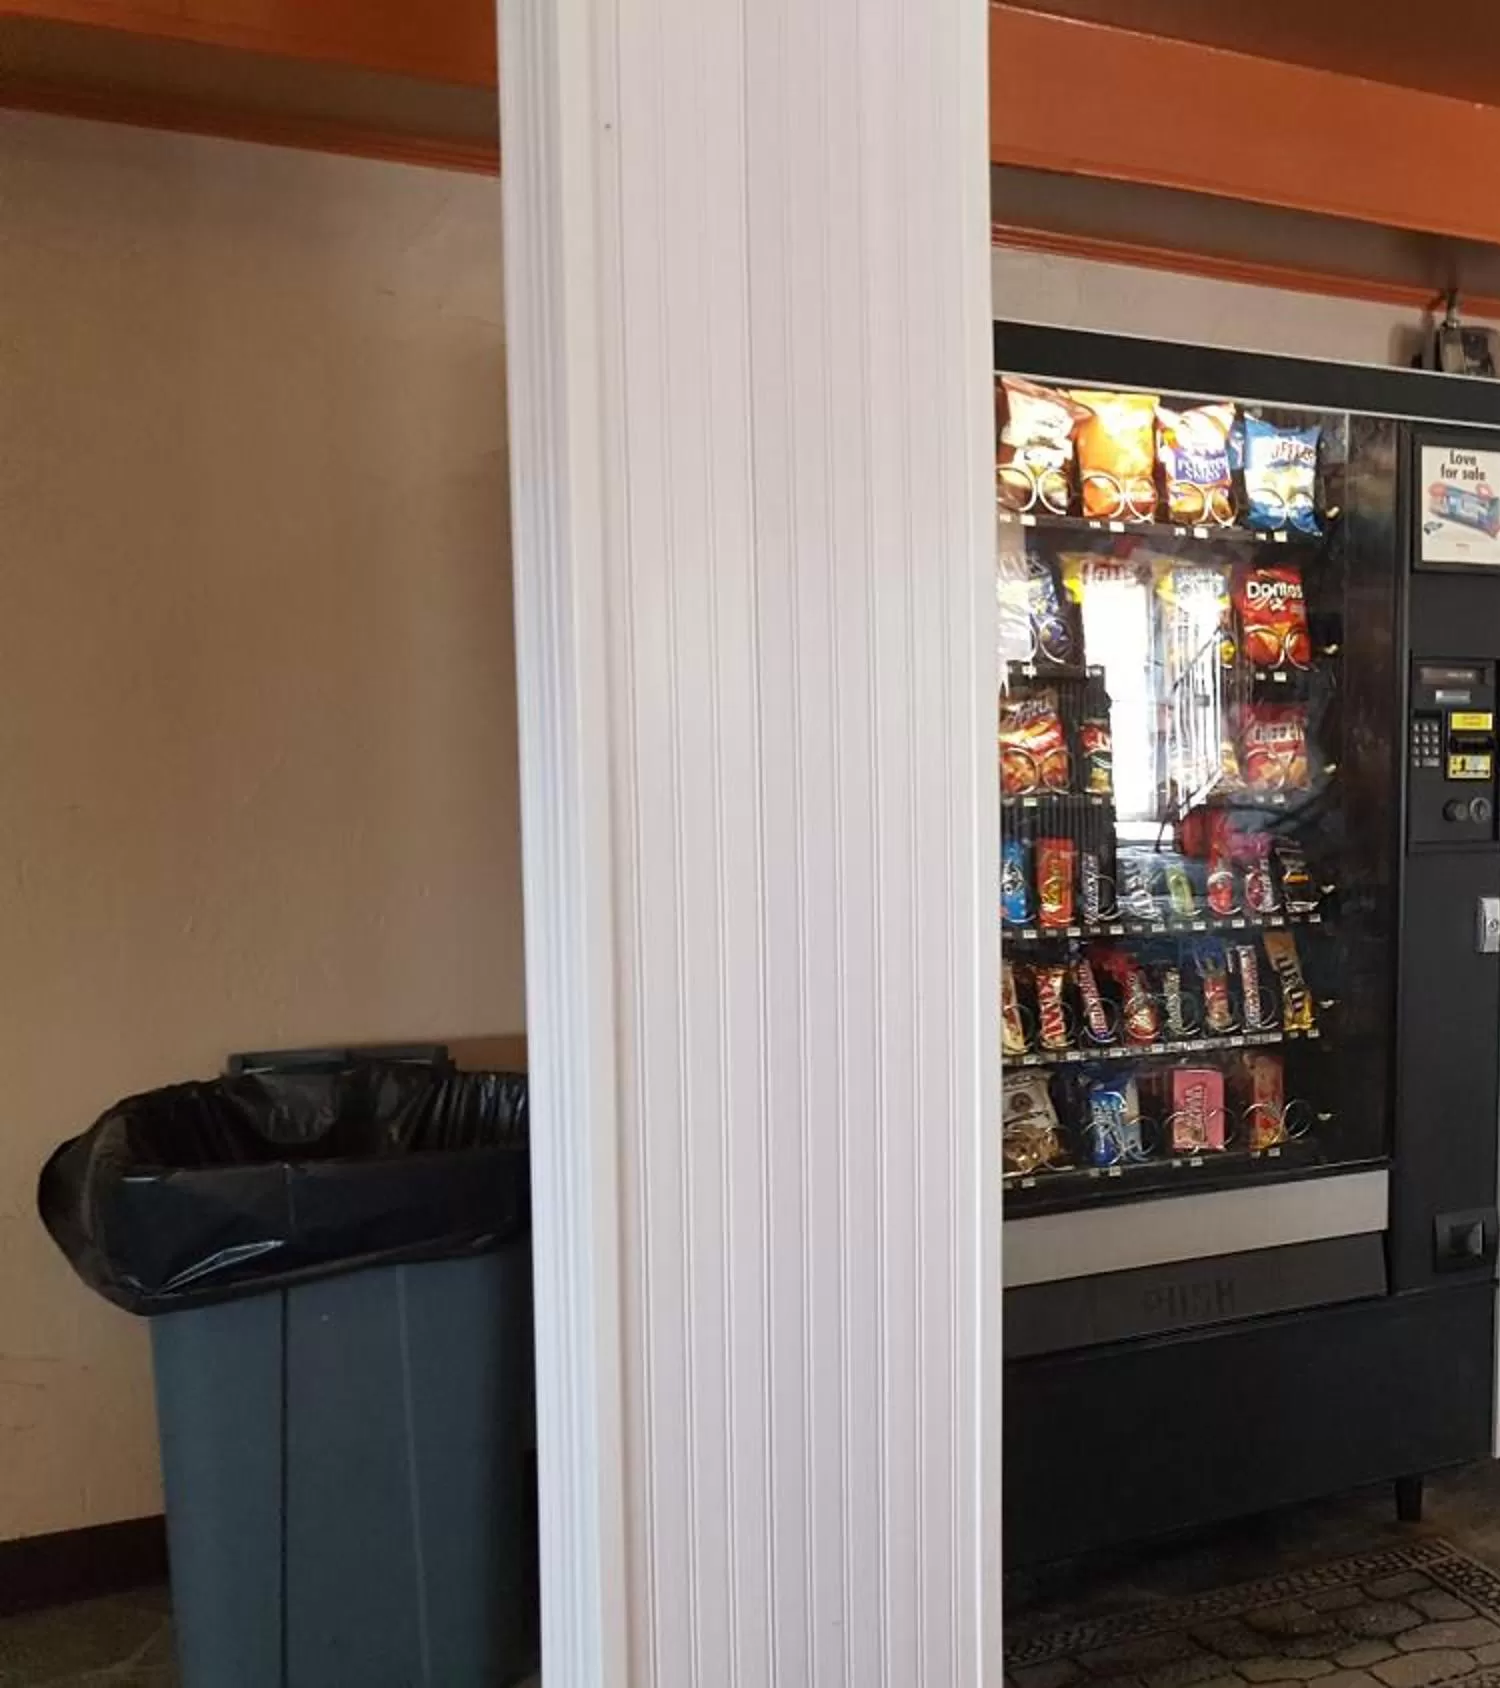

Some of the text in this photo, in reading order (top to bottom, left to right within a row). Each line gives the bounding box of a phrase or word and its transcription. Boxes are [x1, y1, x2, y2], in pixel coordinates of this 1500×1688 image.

[1449, 448, 1477, 466] Love
[1440, 463, 1487, 481] for sale
